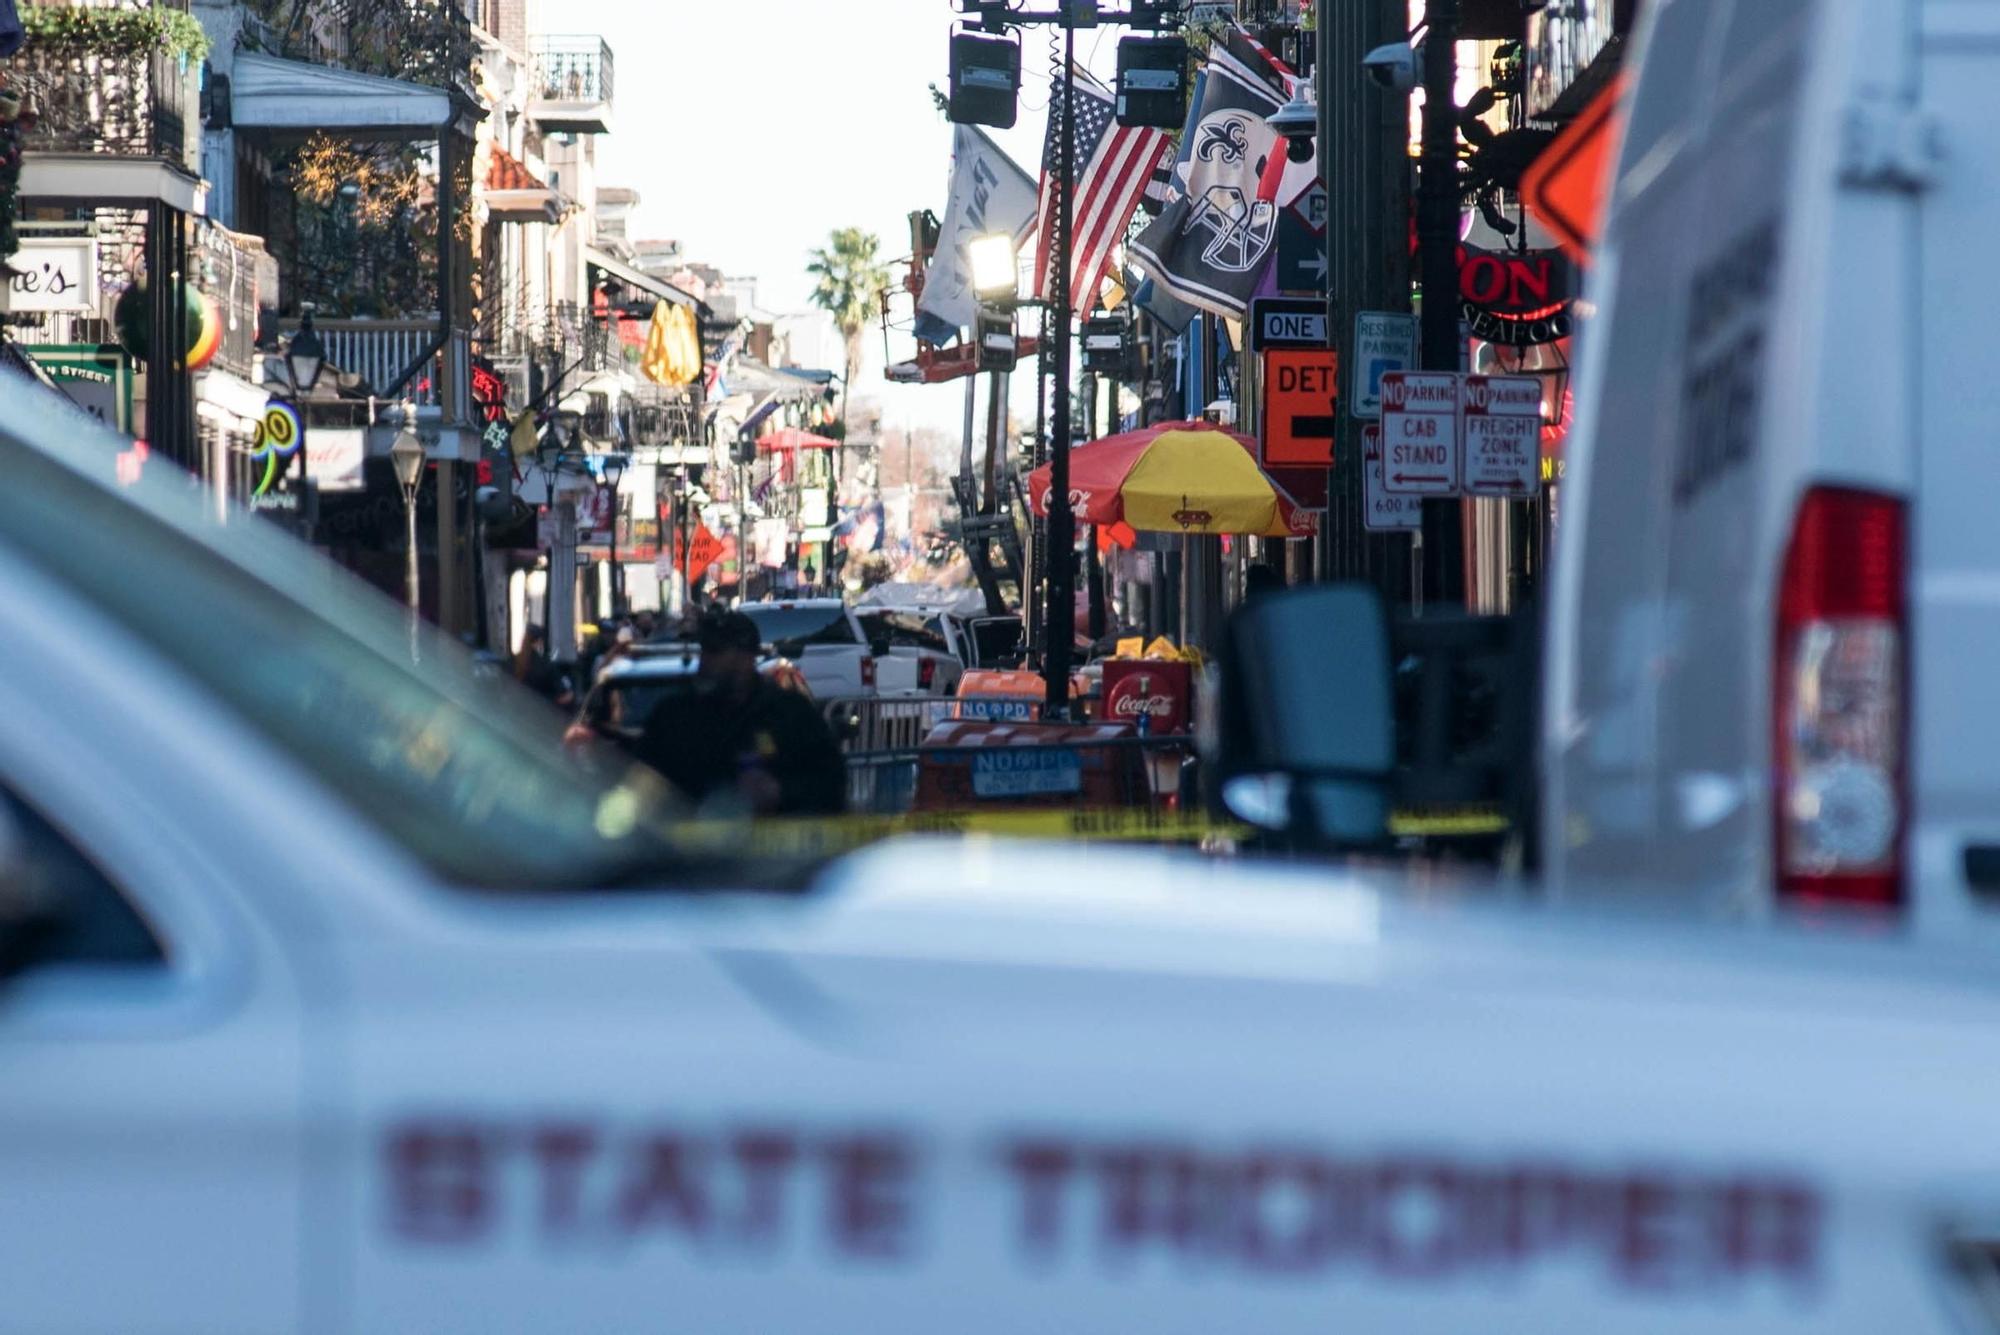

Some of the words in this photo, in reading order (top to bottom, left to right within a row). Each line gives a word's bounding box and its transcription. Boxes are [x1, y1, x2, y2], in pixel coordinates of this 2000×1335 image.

[1269, 316, 1313, 337] ONE
[1279, 365, 1337, 393] DET
[1383, 381, 1404, 404] NO
[1405, 384, 1455, 401] PARKING
[1466, 384, 1487, 408] NO
[1403, 418, 1437, 438] CAB
[1469, 418, 1534, 437] FREIGHT
[1393, 444, 1447, 465] STAND
[1481, 438, 1522, 455] ZONE
[1375, 497, 1402, 513] 6:00
[385, 1115, 922, 1262] STATE
[1000, 1125, 1825, 1293] TROOPER
